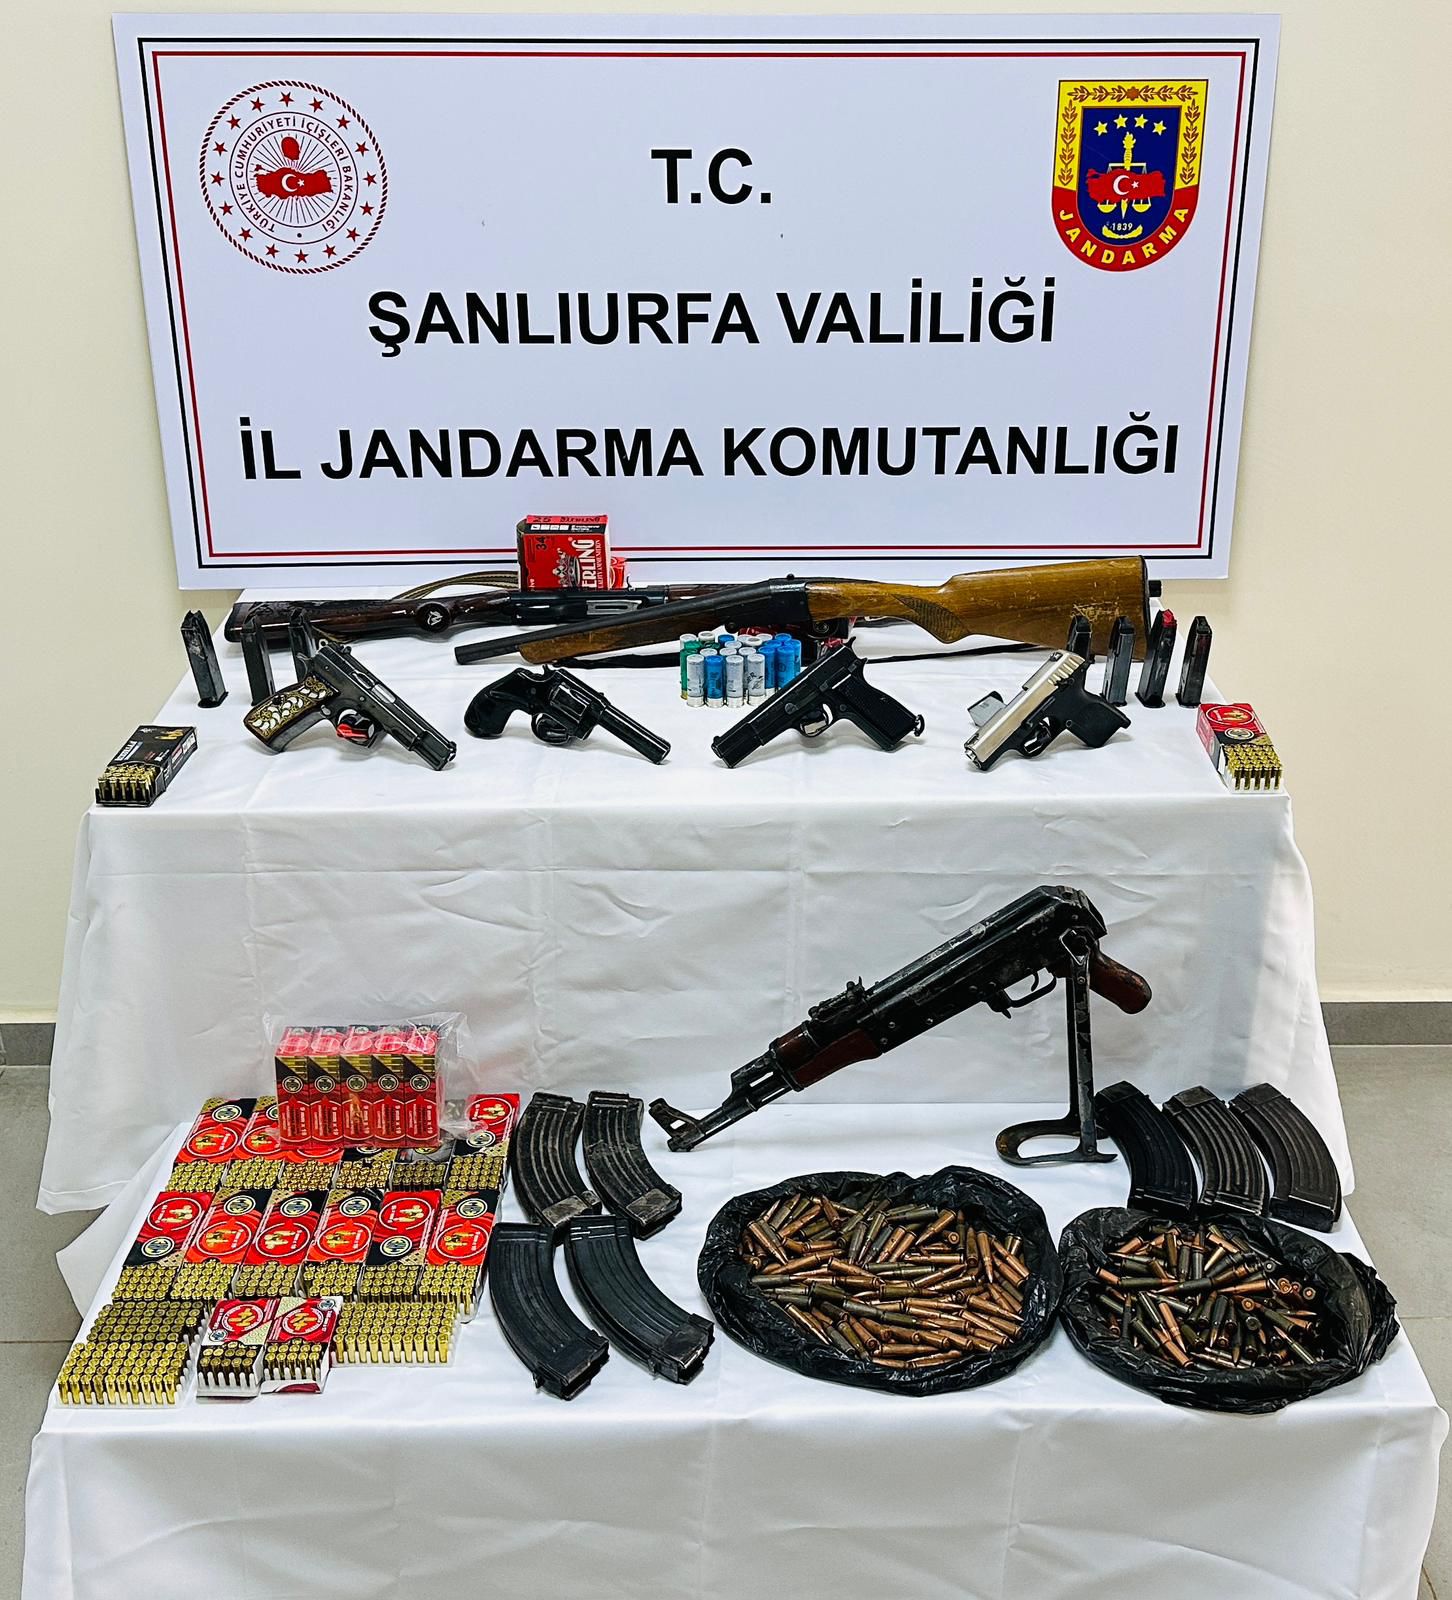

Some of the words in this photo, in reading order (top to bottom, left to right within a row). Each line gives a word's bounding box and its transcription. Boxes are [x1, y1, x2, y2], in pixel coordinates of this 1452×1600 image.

[234, 115, 297, 178] CUMHURİYETİ
[301, 117, 348, 162] İÇİŞLERİ
[321, 165, 354, 232] BAKANLIĞI
[650, 148, 771, 205] T.C.
[1059, 208, 1189, 264] JANDARMA
[1111, 222, 1134, 231] 1839
[368, 291, 760, 358] ŞANLIURFA
[775, 276, 1056, 344] VALİLİĞİ
[239, 416, 302, 480] İL
[320, 428, 705, 480] JANDARMA
[723, 411, 1179, 477] KOMUTANLIĞI
[535, 537, 548, 550] 34
[571, 539, 598, 588] ERLING
